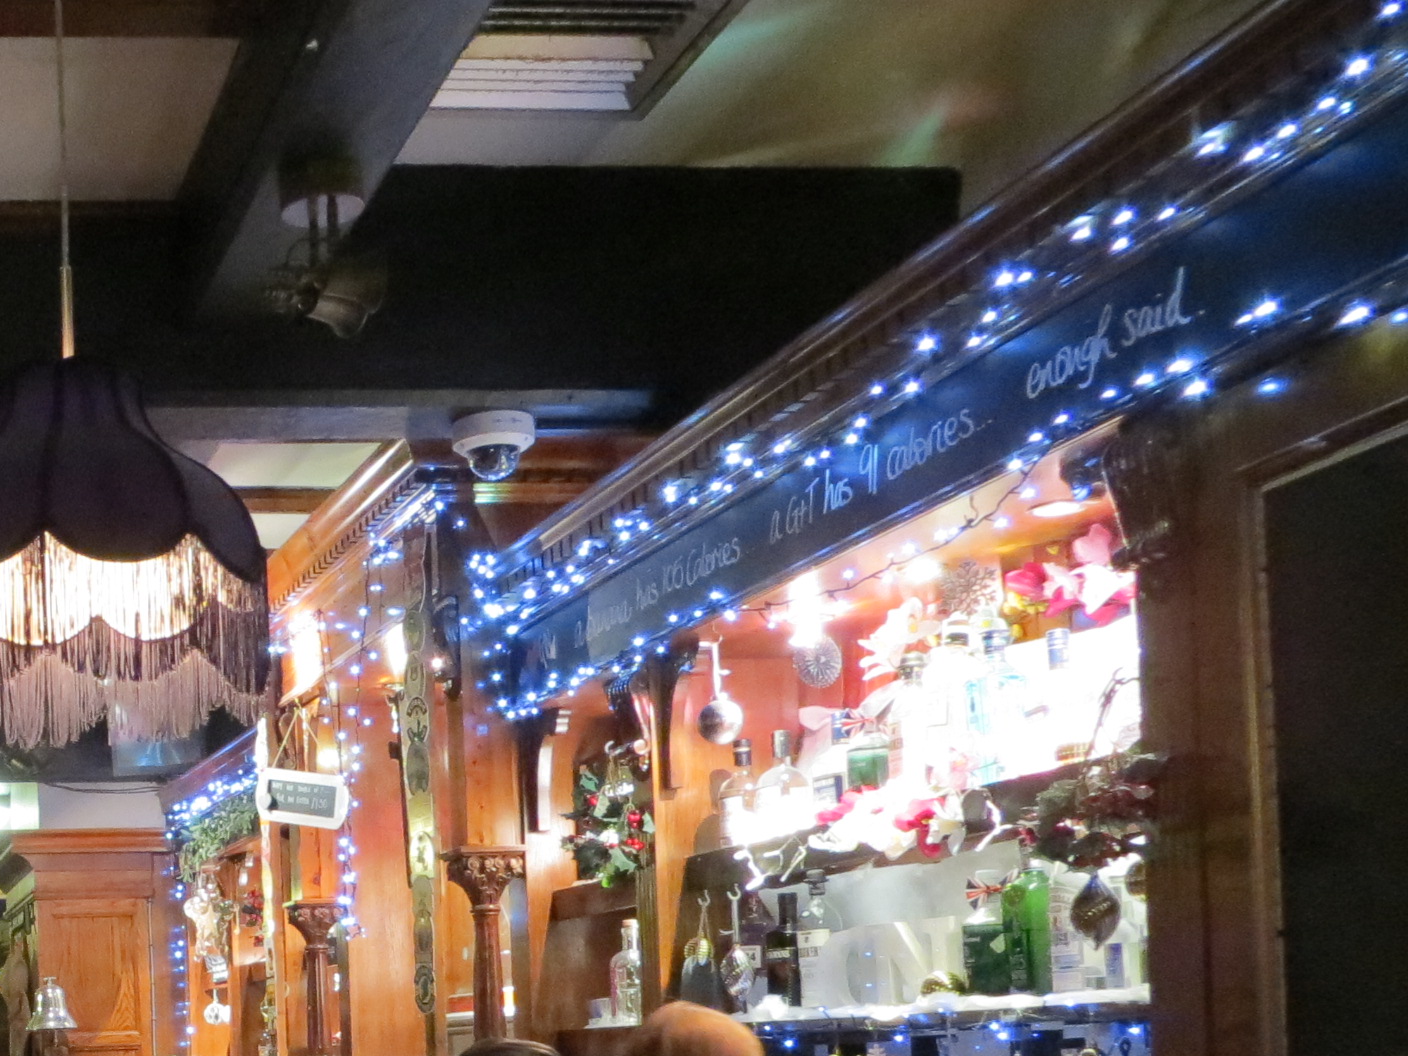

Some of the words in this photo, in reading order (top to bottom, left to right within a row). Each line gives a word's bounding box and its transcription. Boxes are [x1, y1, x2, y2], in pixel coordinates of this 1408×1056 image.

[1026, 304, 1117, 399] enough
[769, 510, 783, 544] a
[822, 468, 854, 514] has
[858, 444, 879, 494] 91
[636, 577, 659, 609] has
